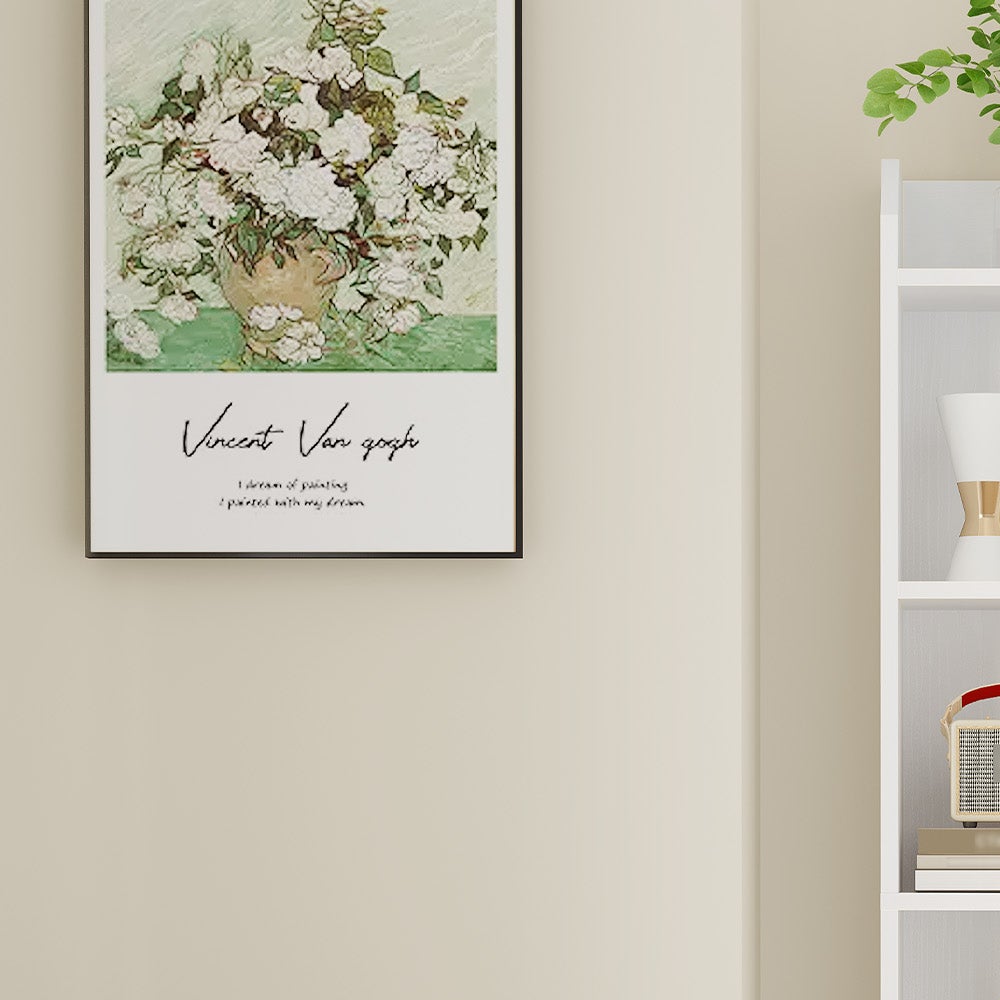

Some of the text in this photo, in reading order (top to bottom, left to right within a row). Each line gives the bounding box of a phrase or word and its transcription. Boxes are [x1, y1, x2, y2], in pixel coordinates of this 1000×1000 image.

[182, 401, 285, 458] Vincent
[299, 401, 352, 458] Van
[300, 478, 348, 494] painting
[326, 496, 365, 507] dream
